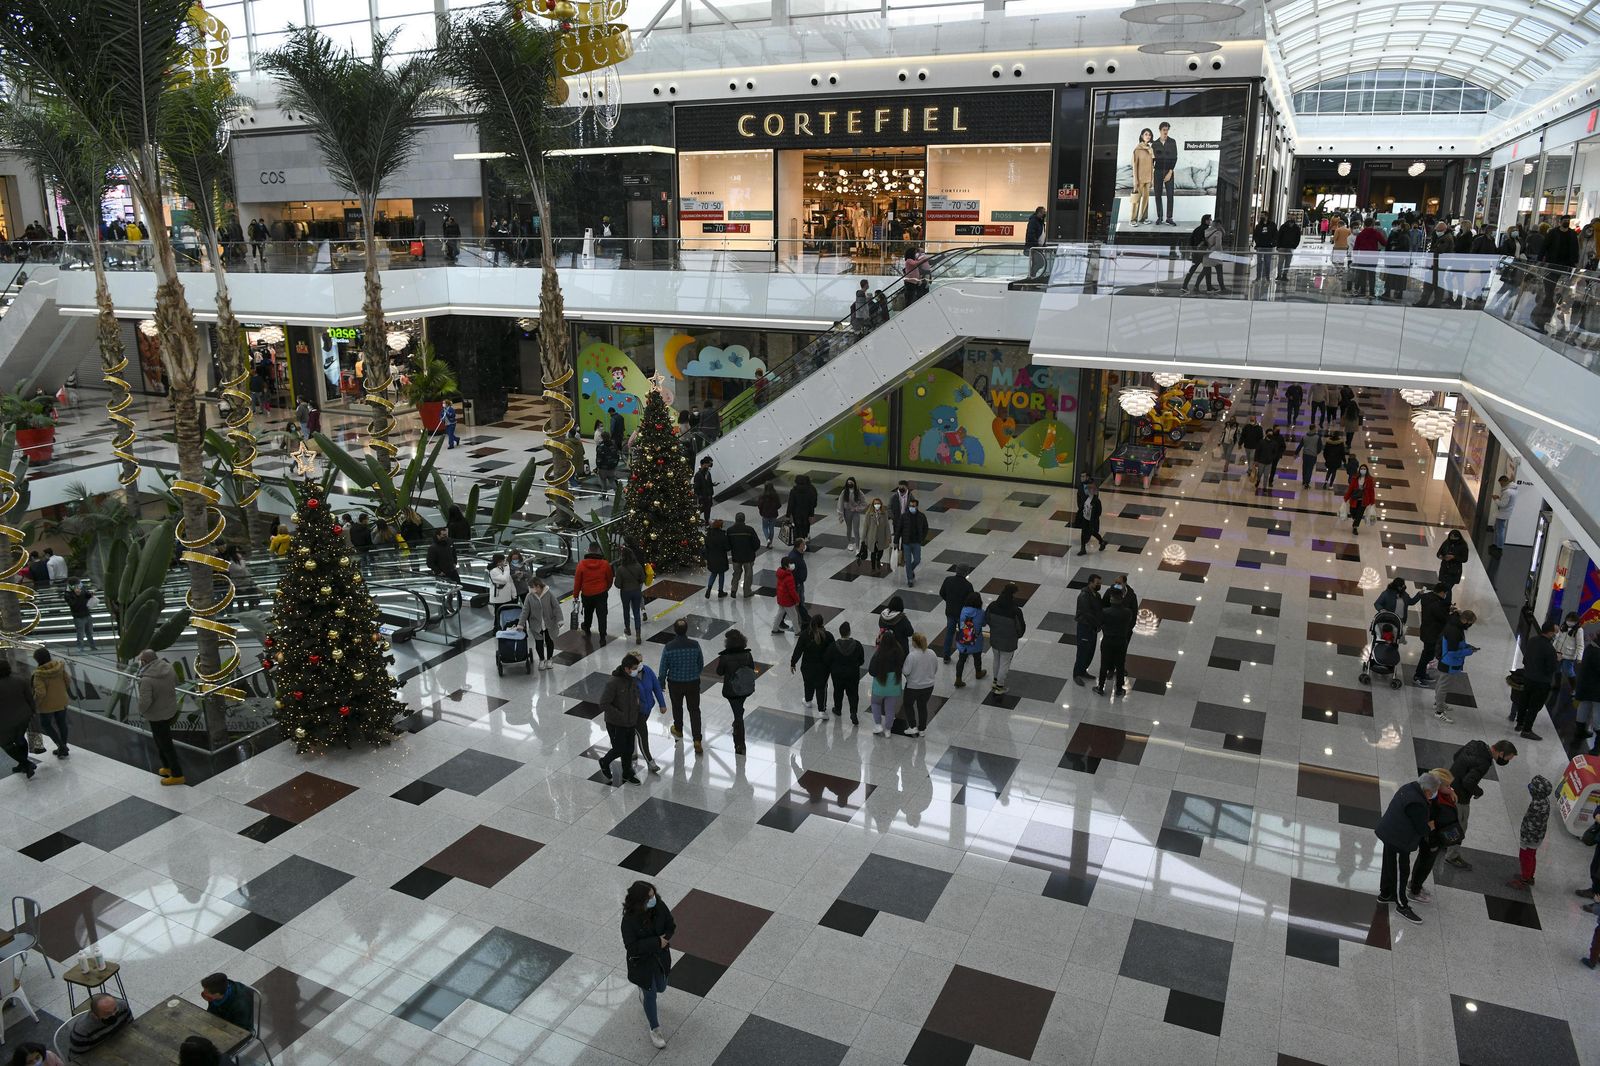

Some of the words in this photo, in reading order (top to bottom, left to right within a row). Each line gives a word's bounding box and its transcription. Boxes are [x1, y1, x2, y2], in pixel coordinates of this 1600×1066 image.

[737, 106, 967, 137] CORTEFIEL
[259, 171, 286, 185] COS
[432, 203, 449, 212] COS
[991, 366, 1078, 389] MAGIC
[991, 389, 1078, 412] WORLD
